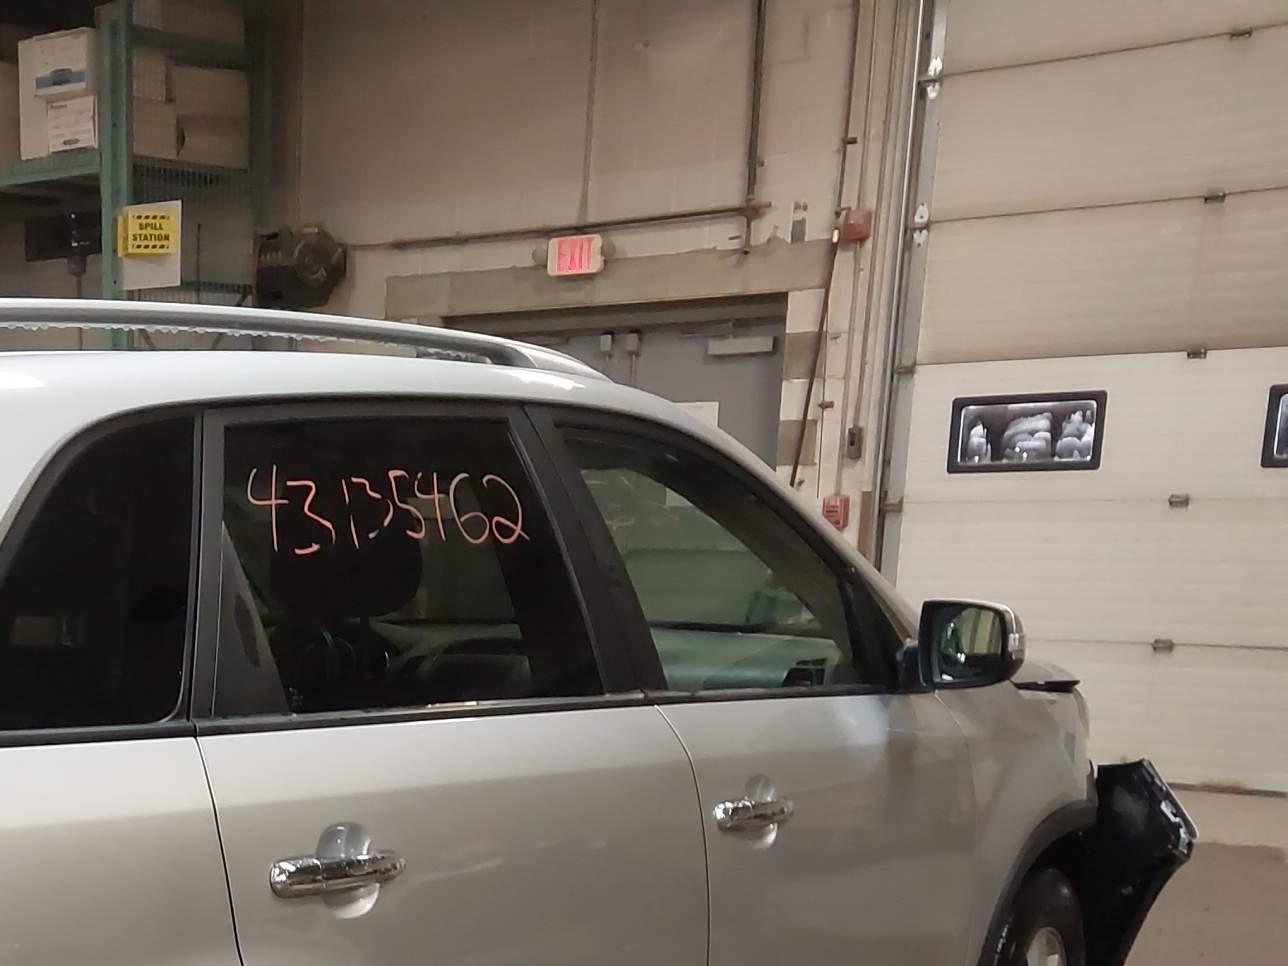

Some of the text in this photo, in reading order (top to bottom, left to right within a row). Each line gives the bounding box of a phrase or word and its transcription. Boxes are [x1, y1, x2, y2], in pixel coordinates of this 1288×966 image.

[139, 222, 164, 231] SPILL
[132, 233, 170, 242] STATION
[557, 238, 594, 271] EXIT
[246, 463, 531, 555] 43135462
